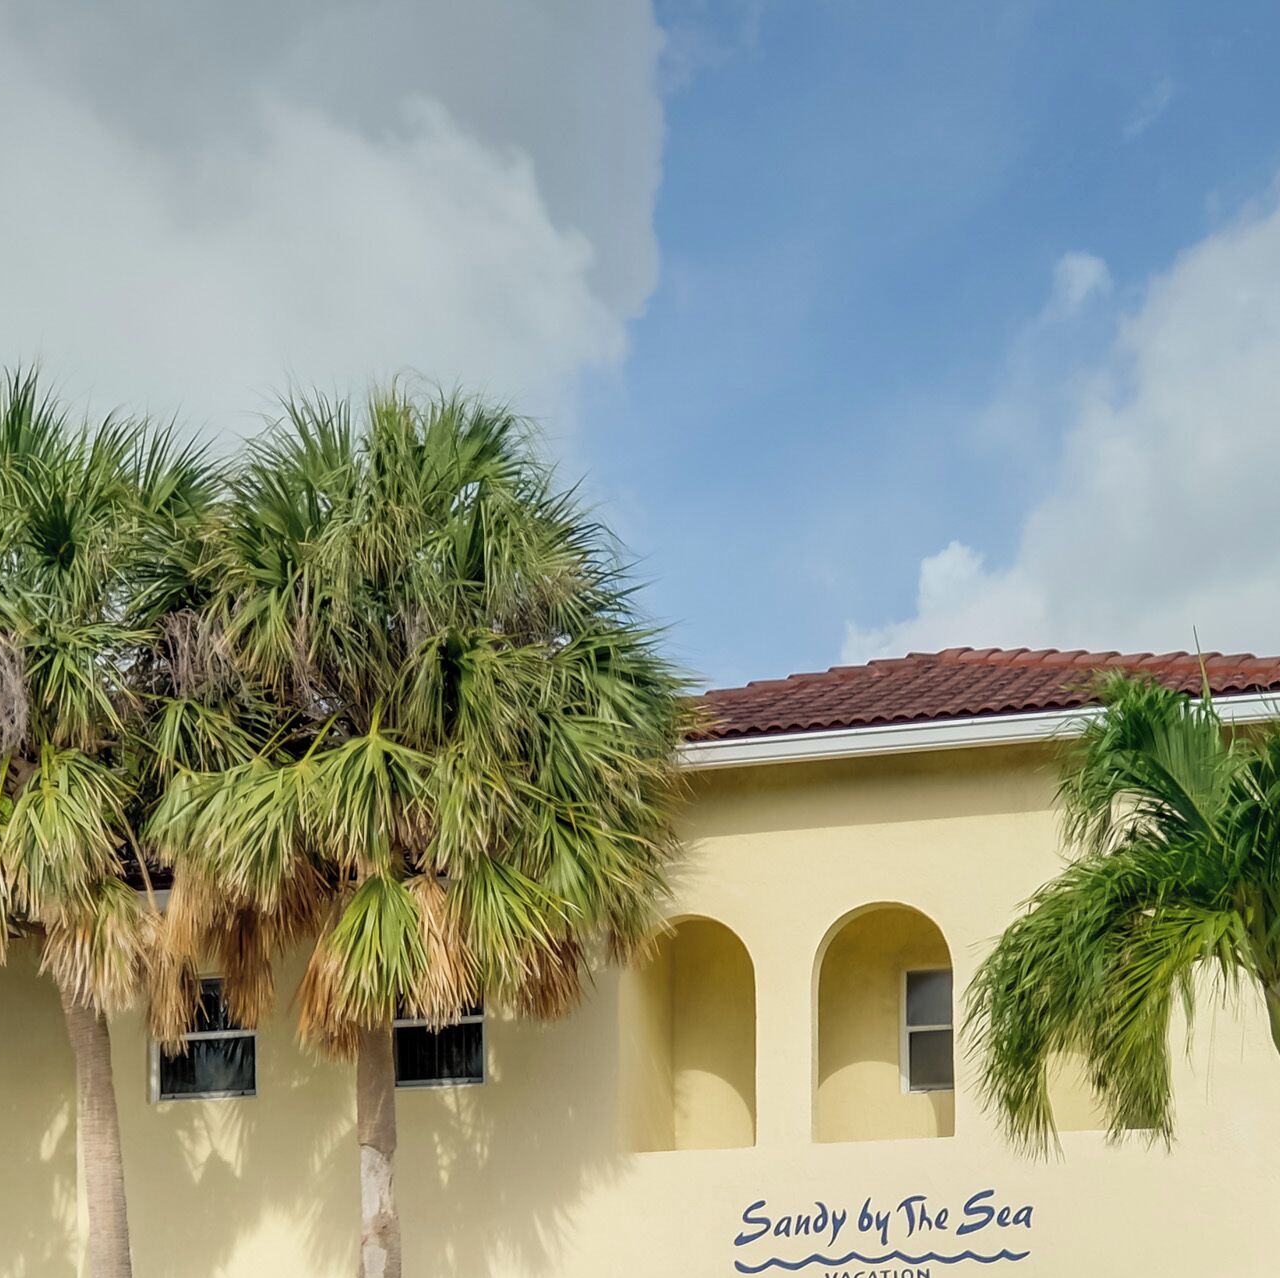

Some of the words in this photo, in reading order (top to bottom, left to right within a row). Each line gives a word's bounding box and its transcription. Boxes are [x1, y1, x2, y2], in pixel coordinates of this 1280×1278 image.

[733, 1199, 847, 1247] Sandy
[857, 1196, 891, 1246] by
[895, 1194, 949, 1238] The
[955, 1188, 1034, 1236] Sea
